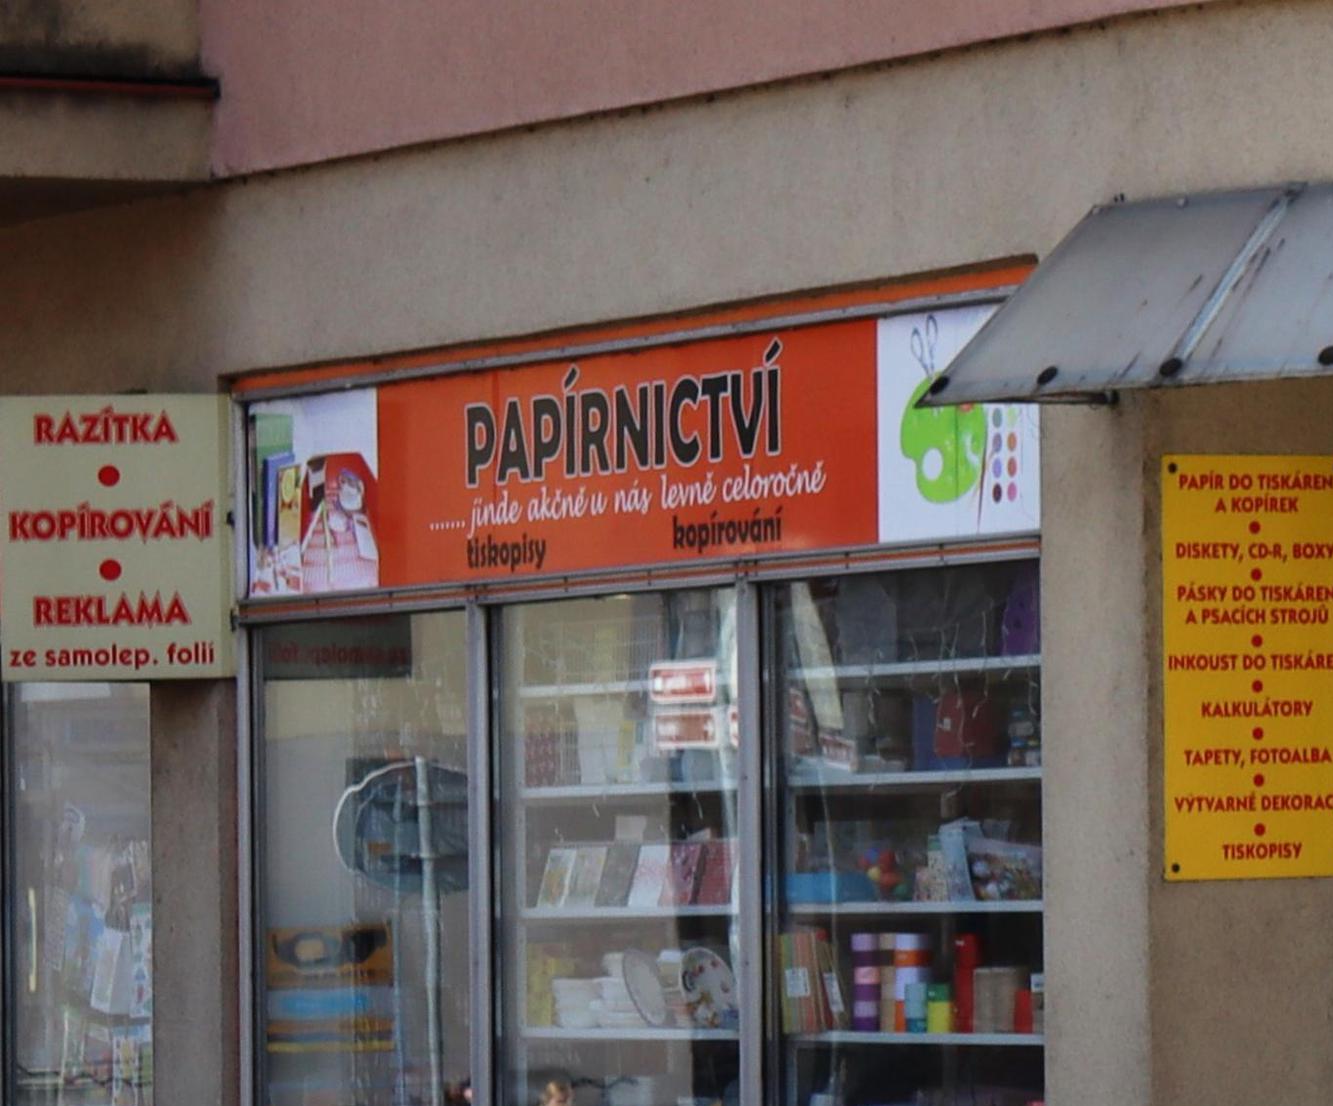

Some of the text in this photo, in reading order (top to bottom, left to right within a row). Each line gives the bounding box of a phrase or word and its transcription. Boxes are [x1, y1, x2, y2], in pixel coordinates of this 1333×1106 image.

[465, 337, 783, 488] PAPÍRNICTVÍ
[33, 405, 179, 445] RAZÍTKA
[1178, 470, 1333, 490] PAPÍR DO TISKÁREN
[467, 490, 522, 539] jinde
[590, 493, 607, 518] u
[614, 480, 652, 515] nás
[661, 472, 716, 510] levně
[722, 460, 826, 502] celoročně
[1215, 493, 1299, 513] A KOPÍREK
[8, 499, 215, 543] KOPÍROVÁNÍ
[672, 506, 783, 554] kopírování
[466, 533, 546, 573] tiskopisy
[1175, 542, 1244, 564] DISKETY,
[1248, 542, 1288, 564] CD-R,
[1177, 582, 1227, 602] PÁSKY
[1232, 586, 1255, 601] DO
[33, 591, 191, 628] REKLAMA
[1185, 603, 1329, 624] A PSACÍCH STROJŮ
[9, 649, 36, 668] ze
[45, 644, 159, 669] samolep.
[1168, 654, 1238, 671] INKOUST
[1242, 655, 1266, 670] DO
[1201, 697, 1313, 718] KALKULÁTORY
[1184, 747, 1332, 769] TAPETY, FOTOALBA
[1175, 790, 1256, 812] VÝTVARNÉ
[1222, 842, 1302, 860] TISKOPISY
